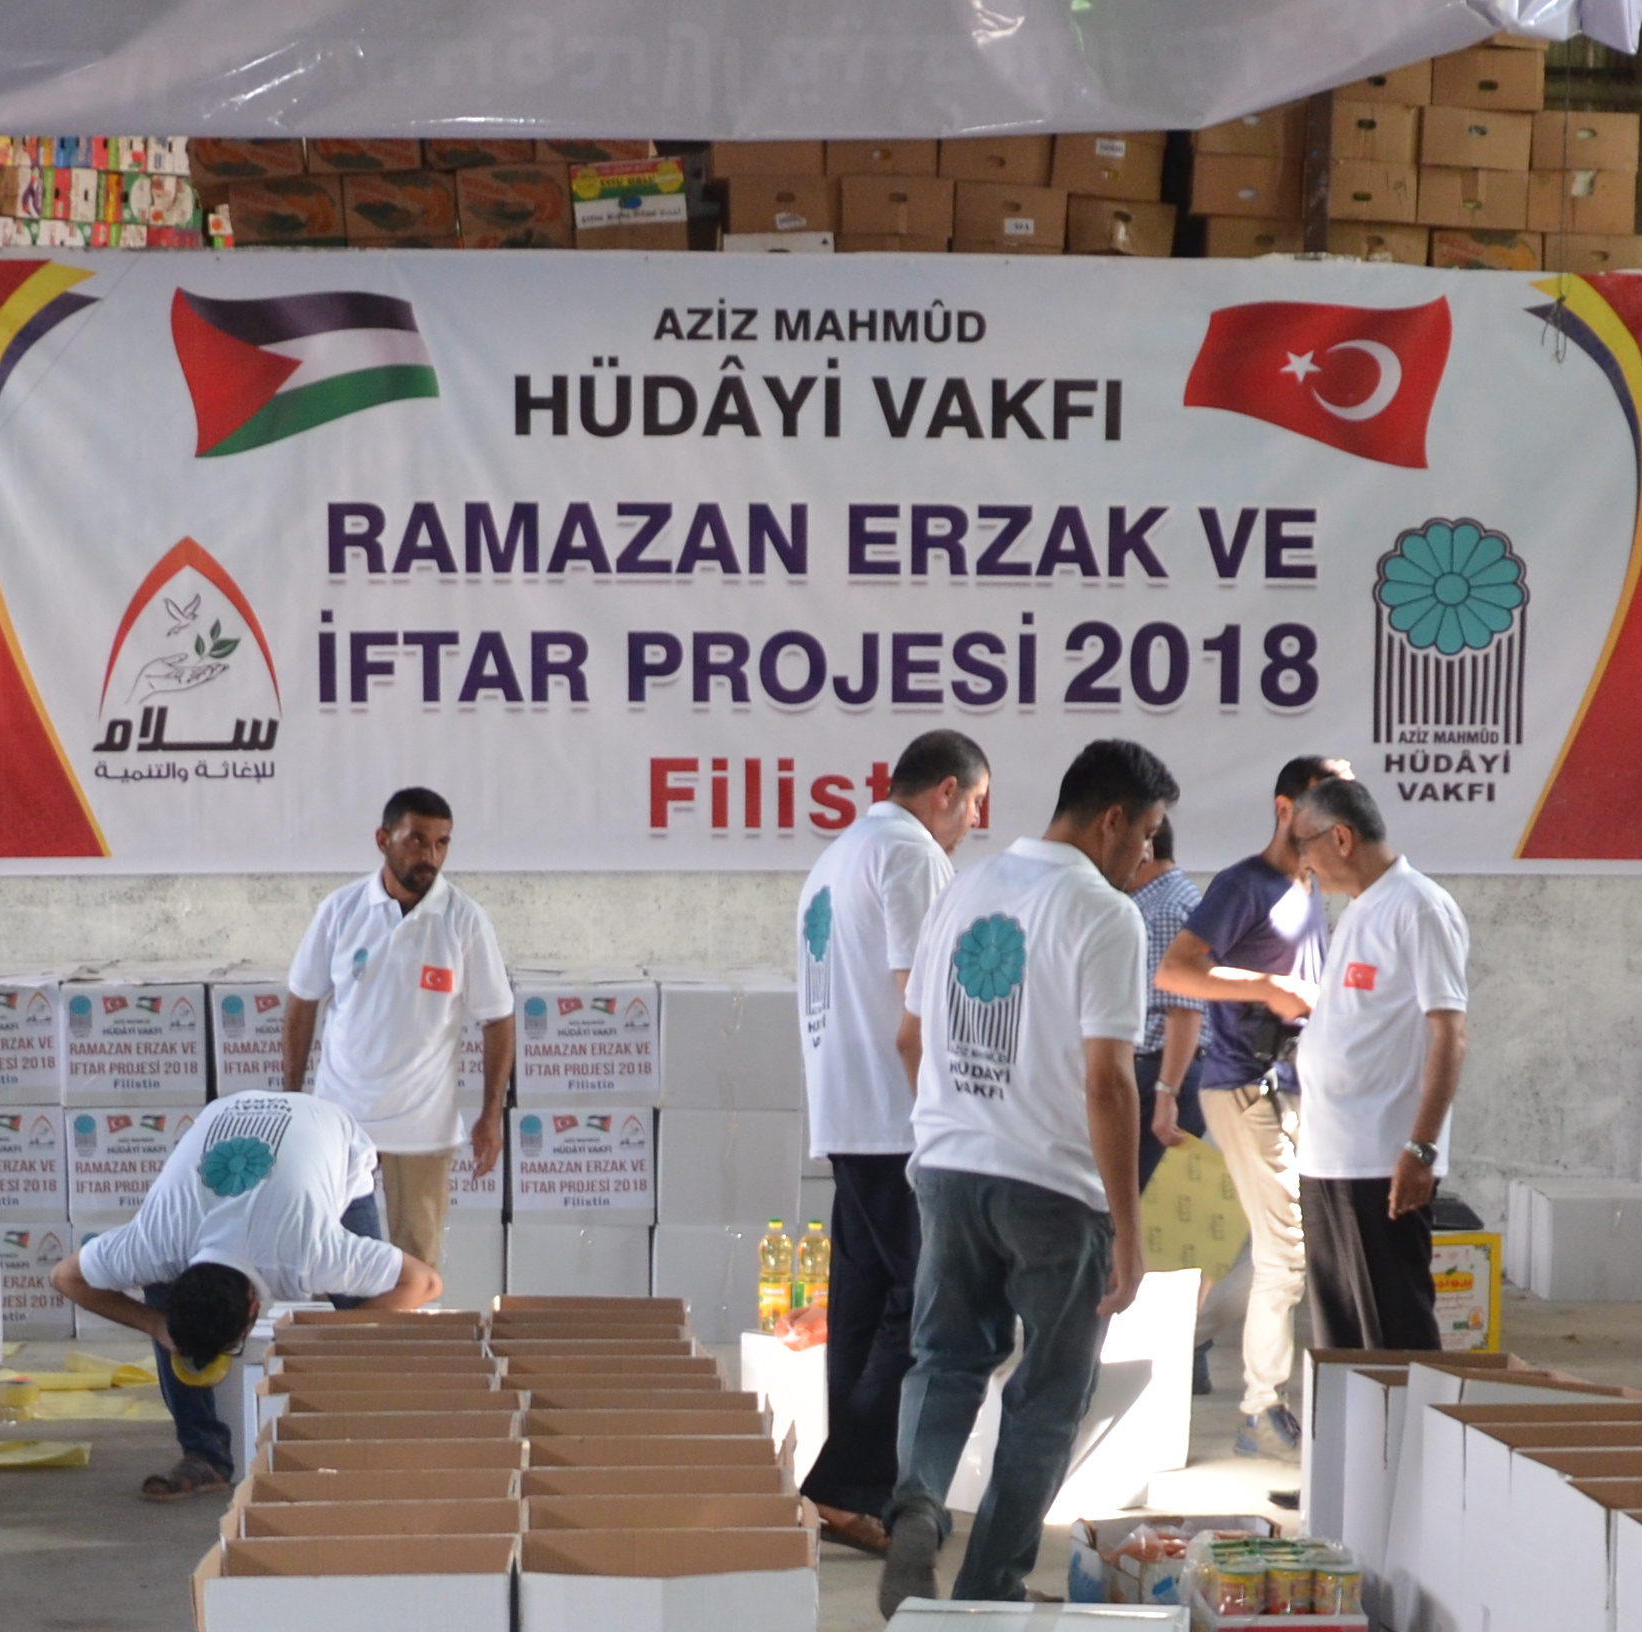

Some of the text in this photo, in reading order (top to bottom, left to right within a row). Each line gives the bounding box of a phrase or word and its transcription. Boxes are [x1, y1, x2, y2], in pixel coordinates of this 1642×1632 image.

[654, 299, 987, 343] AZİZ MAHMÛD
[514, 356, 1122, 441] HÜDÂYİ VAKFI
[327, 502, 1318, 580] RAMAZAN ERZAK VE
[318, 609, 1320, 708] İFTAR PROJESİ 2018
[1398, 727, 1500, 745] AZİZ MAHMÛD
[1384, 749, 1511, 774] HÜDÂYİ
[650, 757, 990, 831] Filist
[1397, 782, 1496, 802] VAKFI
[38, 1035, 54, 1049] VE
[69, 1041, 197, 1055] RAMAZAN ERZAK VE
[524, 1042, 652, 1057] RAMAZAN ERZAK VE
[22, 1056, 56, 1070] 2018
[164, 1061, 199, 1074] 2018
[525, 1060, 652, 1077] İFTAR PROJESİ 2018
[113, 1078, 161, 1089] Filistin
[568, 1079, 615, 1090] Filistin
[41, 1159, 56, 1172] VE
[75, 1161, 165, 1174] RAMAZAN ERZ
[520, 1158, 647, 1174] RAMAZAN ERZAK VE
[23, 1179, 58, 1192] 2018
[521, 1177, 648, 1194] İFTAR PROJESİ 2018
[563, 1196, 610, 1207] Filistin
[3, 1276, 45, 1289] ERZAK
